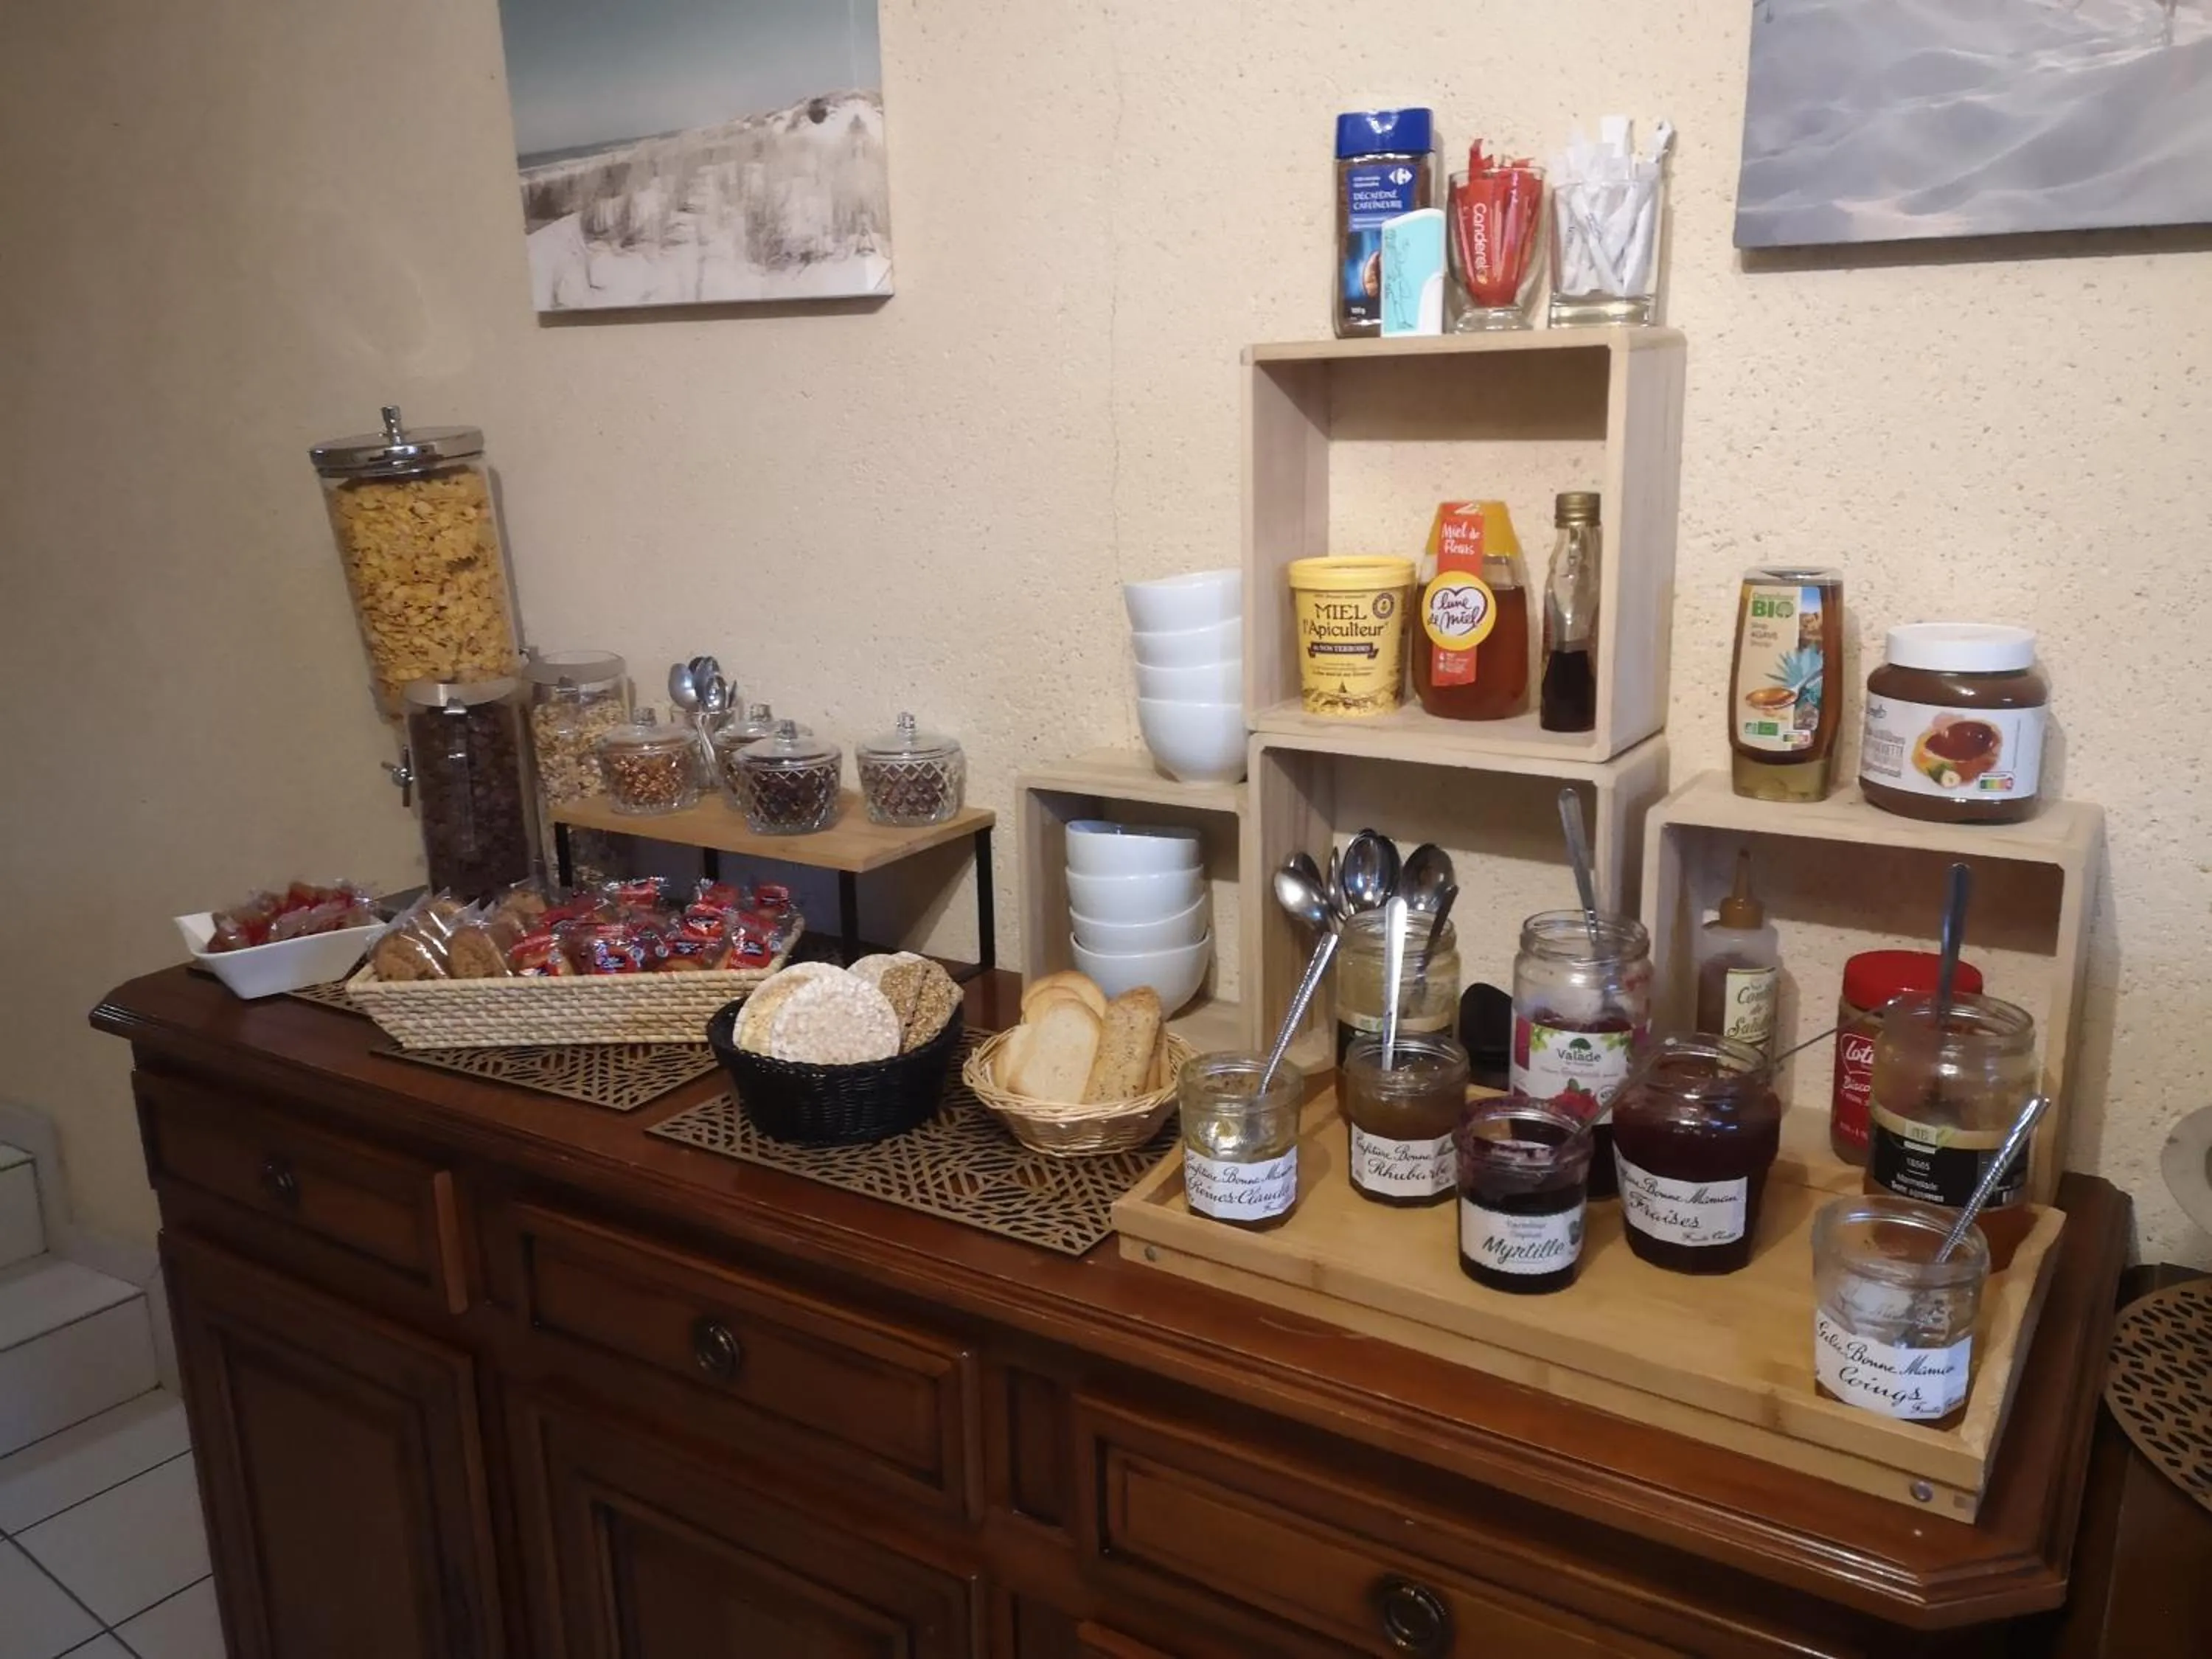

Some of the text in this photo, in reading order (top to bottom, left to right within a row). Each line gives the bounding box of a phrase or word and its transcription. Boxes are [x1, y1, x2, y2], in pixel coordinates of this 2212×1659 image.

[1474, 203, 1491, 269] Canderel
[1442, 521, 1467, 539] Miel
[1315, 603, 1367, 620] MIEL
[1751, 600, 1794, 618] BIO
[1303, 619, 1384, 639] l'Apiculteur
[1557, 1048, 1601, 1062] Valade
[1846, 1040, 1874, 1065] Lot
[1843, 1074, 1871, 1092] Bisco
[1394, 1144, 1435, 1161] Bonne
[1629, 1191, 1700, 1228] Fraises
[1847, 1341, 1898, 1374] Bonne
[1839, 1366, 1924, 1408] Coings
